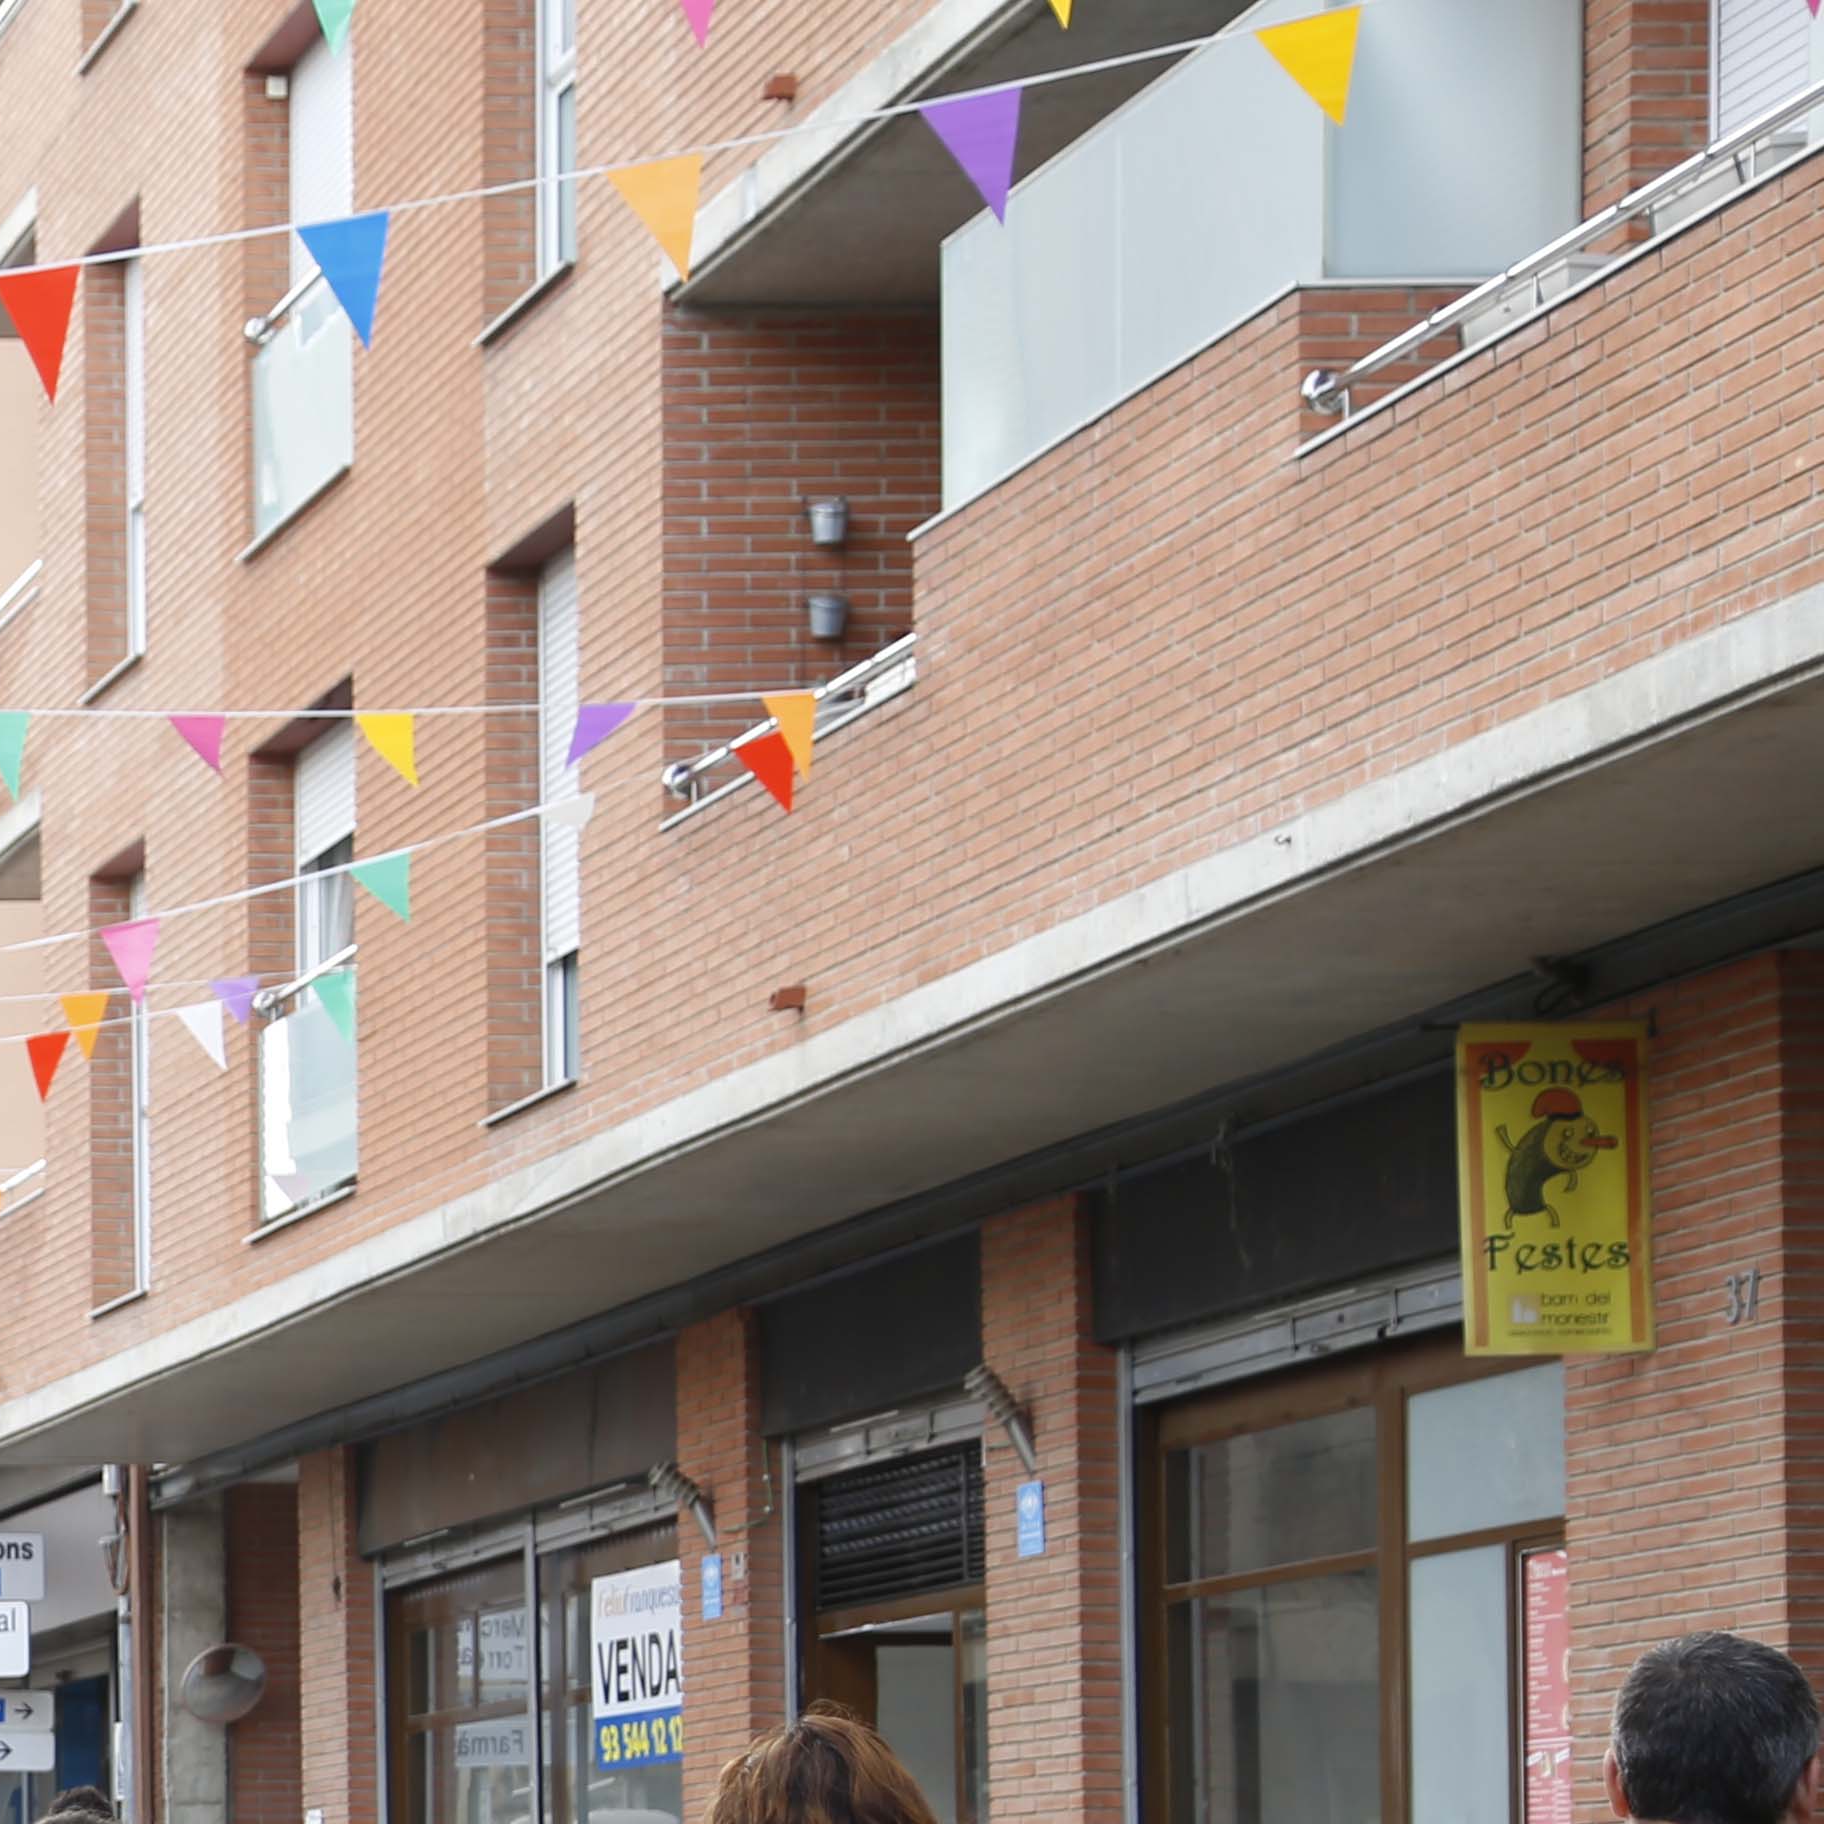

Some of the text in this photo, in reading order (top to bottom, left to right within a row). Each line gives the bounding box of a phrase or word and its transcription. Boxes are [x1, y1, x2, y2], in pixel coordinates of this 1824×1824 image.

[1479, 1052, 1626, 1092] Bones
[1483, 1231, 1631, 1274] Festes
[598, 1629, 681, 1705] VENDA
[600, 1725, 621, 1762] 93
